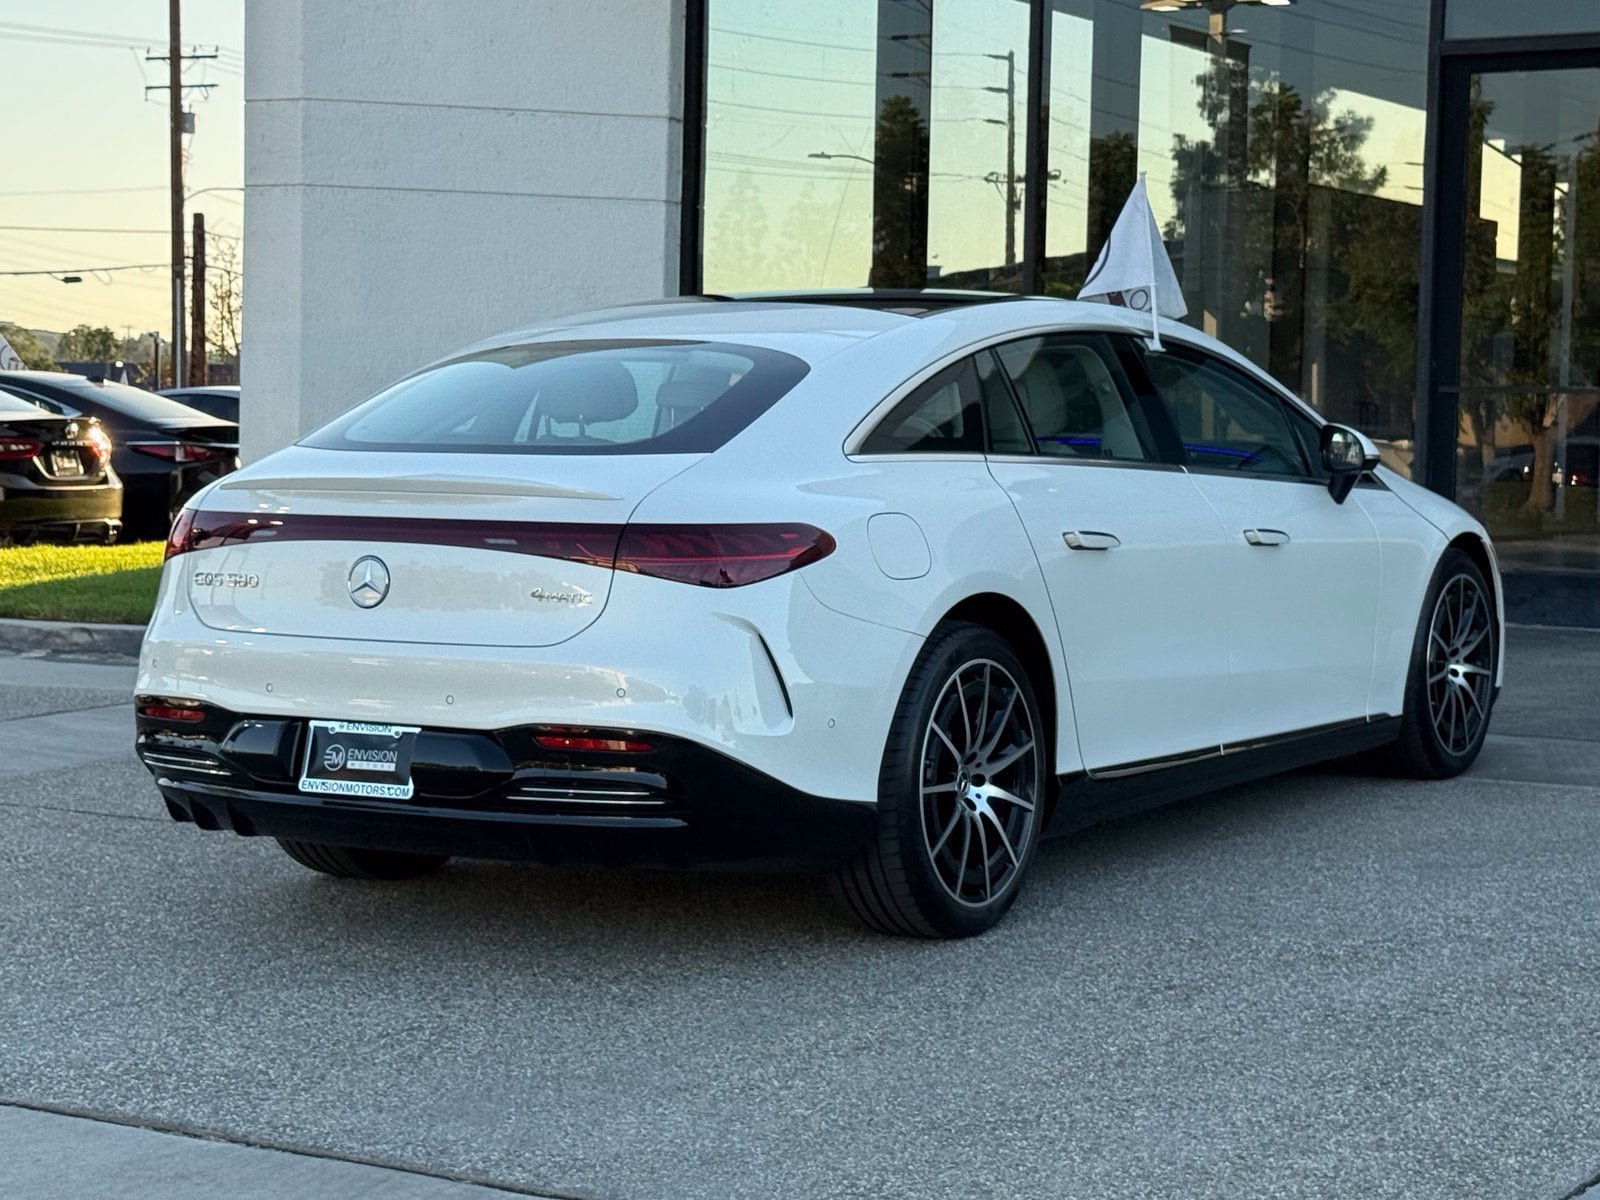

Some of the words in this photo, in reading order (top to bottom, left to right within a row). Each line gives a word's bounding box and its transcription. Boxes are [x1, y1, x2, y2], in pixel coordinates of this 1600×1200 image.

[346, 723, 392, 733] ENVISION
[347, 748, 399, 762] ENVISION
[301, 780, 410, 797] ENVISIONMOTORS.COM
